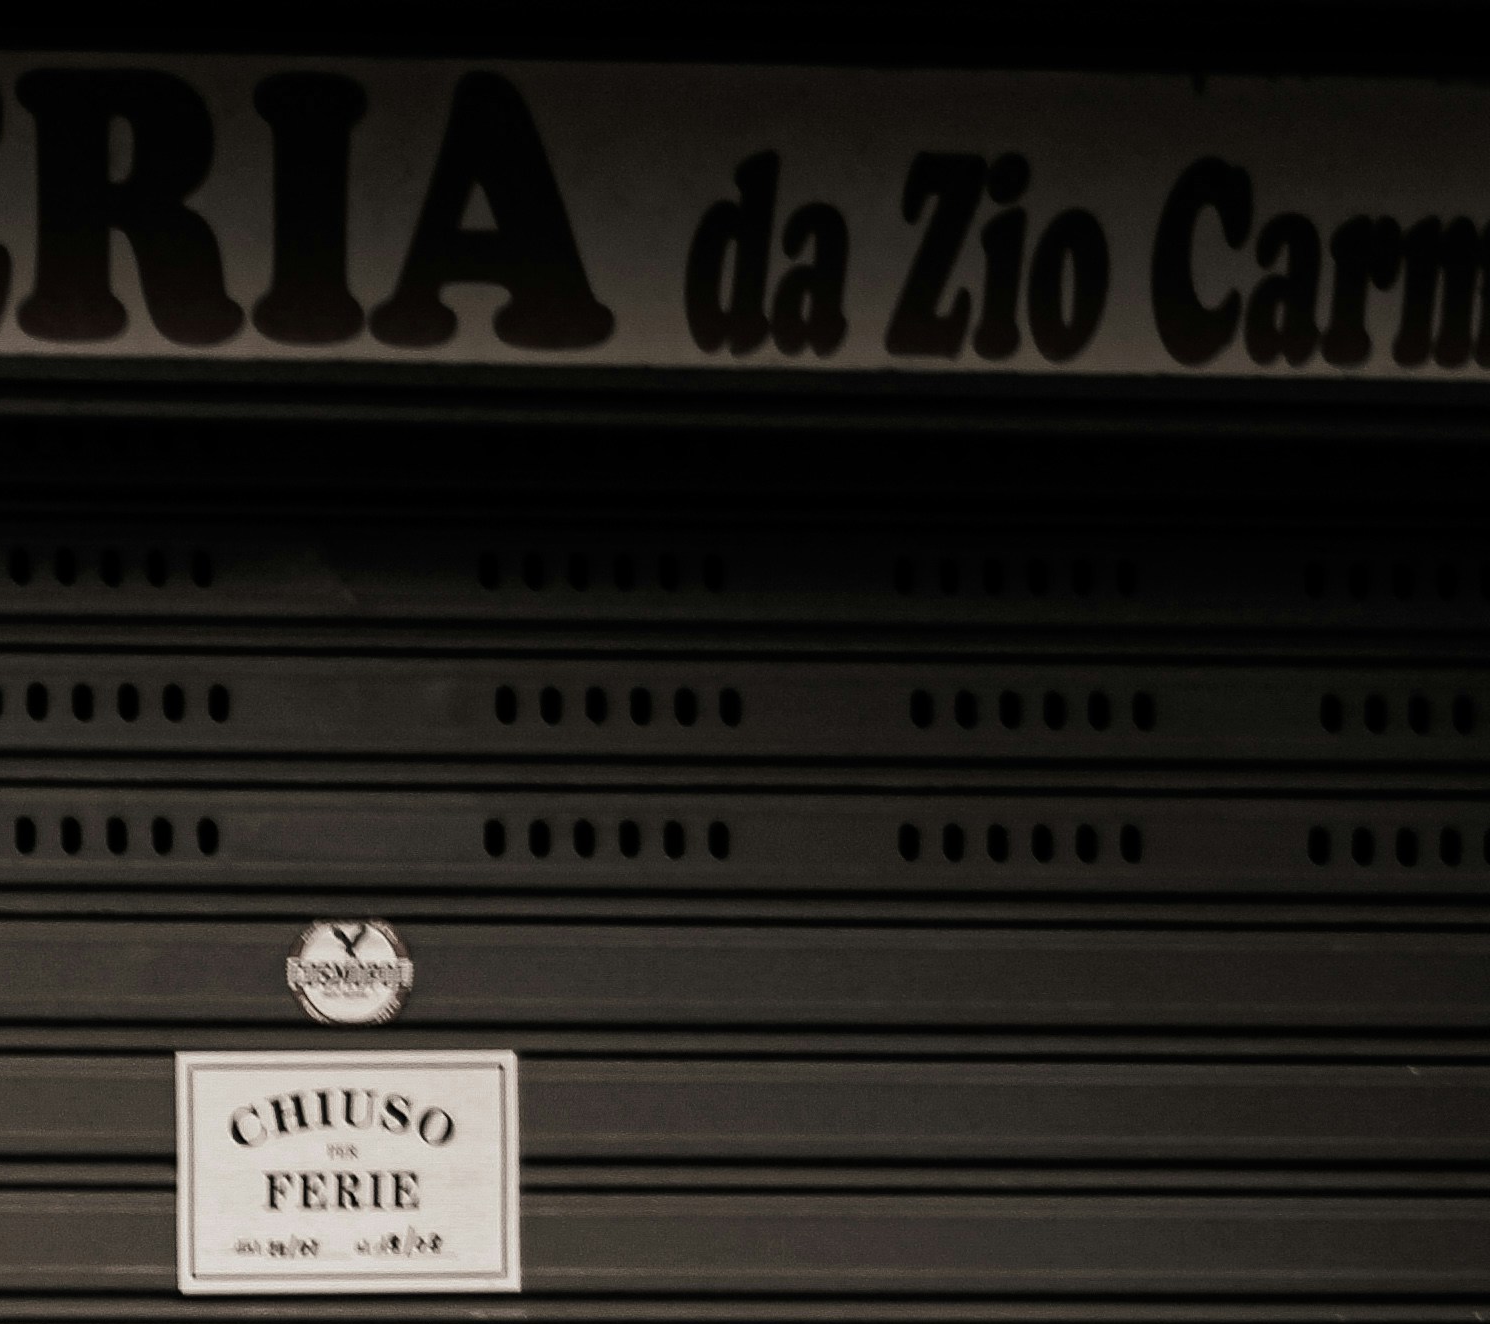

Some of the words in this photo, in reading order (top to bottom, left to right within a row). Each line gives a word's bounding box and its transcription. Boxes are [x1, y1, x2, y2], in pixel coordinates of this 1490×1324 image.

[683, 149, 849, 359] da
[885, 150, 1111, 363] Zio
[230, 1088, 456, 1148] CHIUSO
[262, 1169, 423, 1213] FERIE
